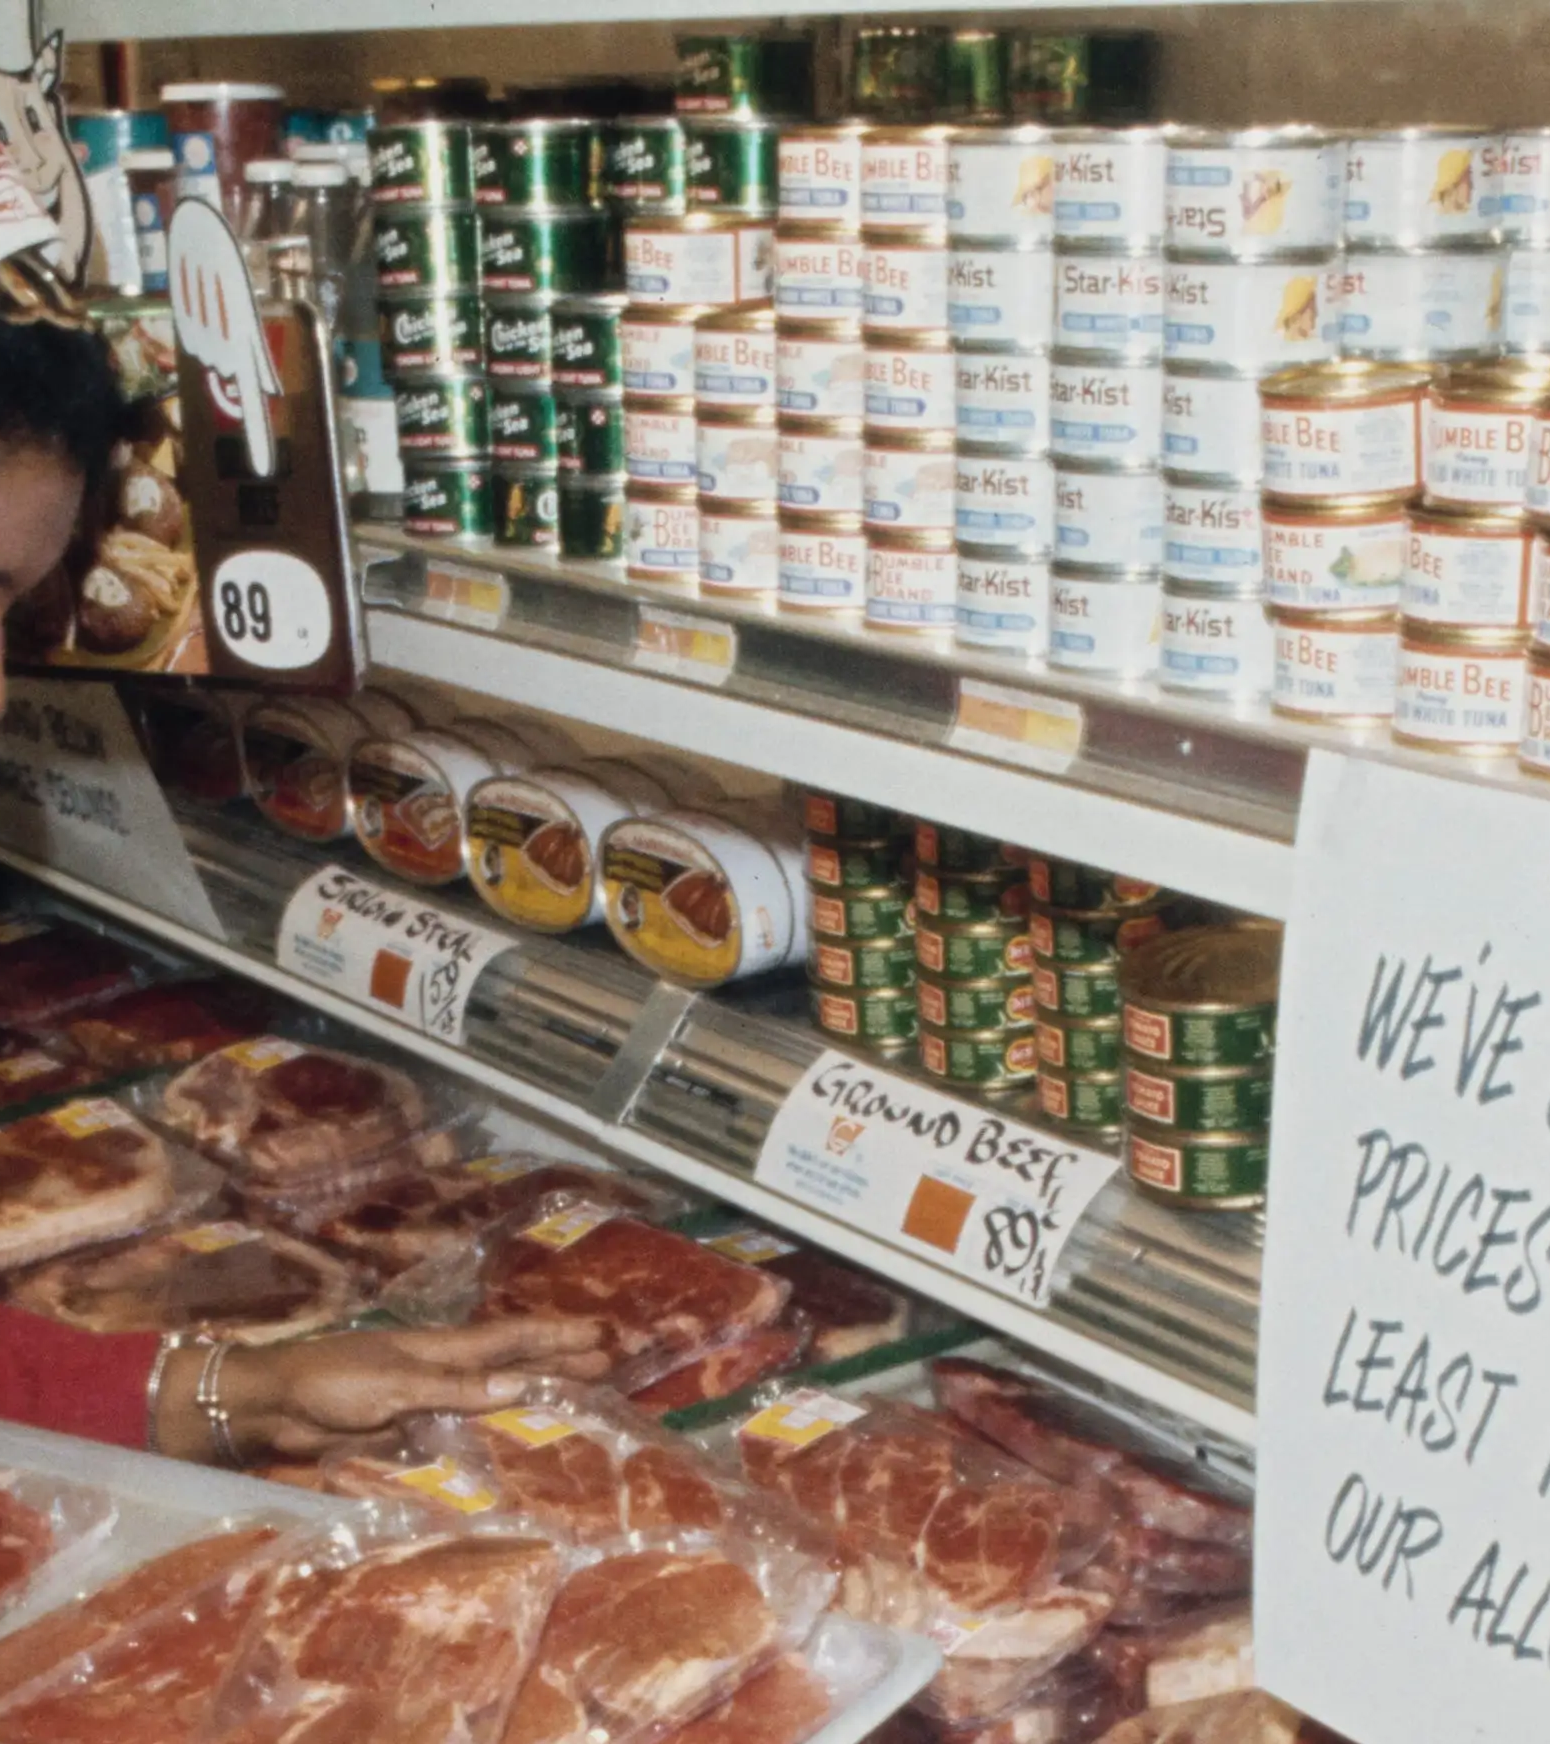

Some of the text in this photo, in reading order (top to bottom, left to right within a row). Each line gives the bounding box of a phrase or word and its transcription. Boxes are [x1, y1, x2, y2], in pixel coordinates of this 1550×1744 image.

[1295, 416, 1342, 454] BEE
[220, 580, 272, 644] 89
[1298, 635, 1338, 673] BEE
[1463, 653, 1512, 701] BEE
[1355, 940, 1542, 1107] WE'VE
[810, 1061, 962, 1150] GROUND
[964, 1117, 1080, 1199] BEEF
[1322, 1307, 1519, 1466] LEAST
[1322, 1471, 1445, 1600] OUR
